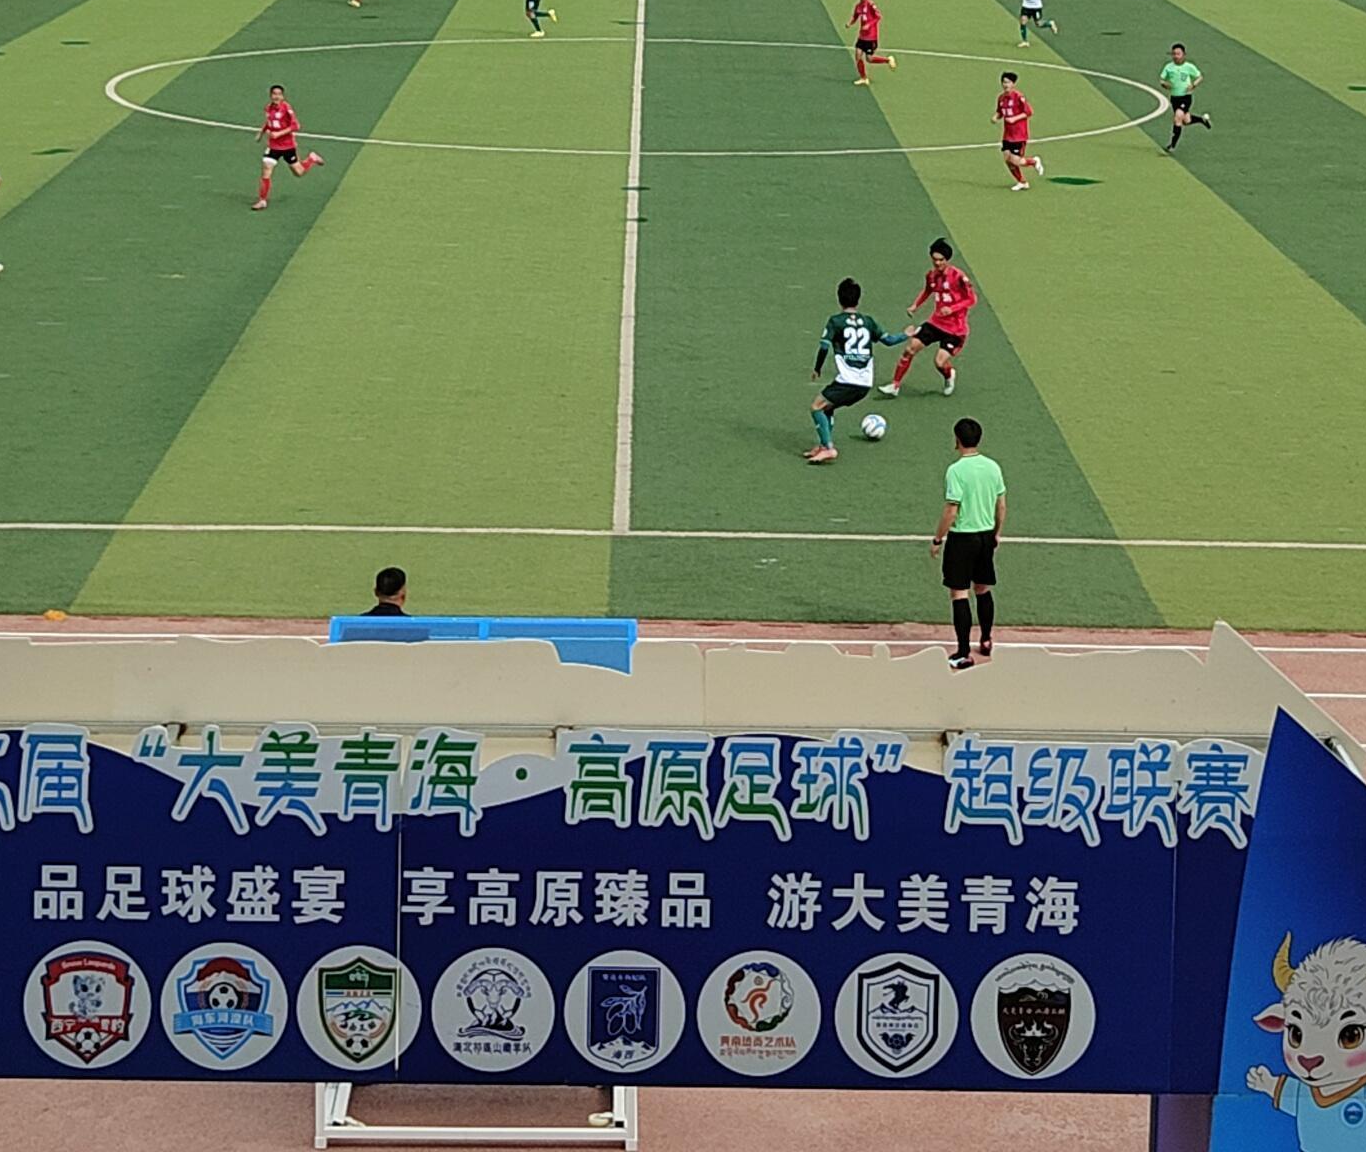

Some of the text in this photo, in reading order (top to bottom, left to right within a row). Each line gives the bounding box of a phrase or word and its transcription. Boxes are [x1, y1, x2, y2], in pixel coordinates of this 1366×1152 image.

[843, 326, 871, 355] 22
[945, 732, 1255, 848] 超级联赛
[33, 864, 1081, 935] 品足球盛宴 享高原臻品 游大美青海
